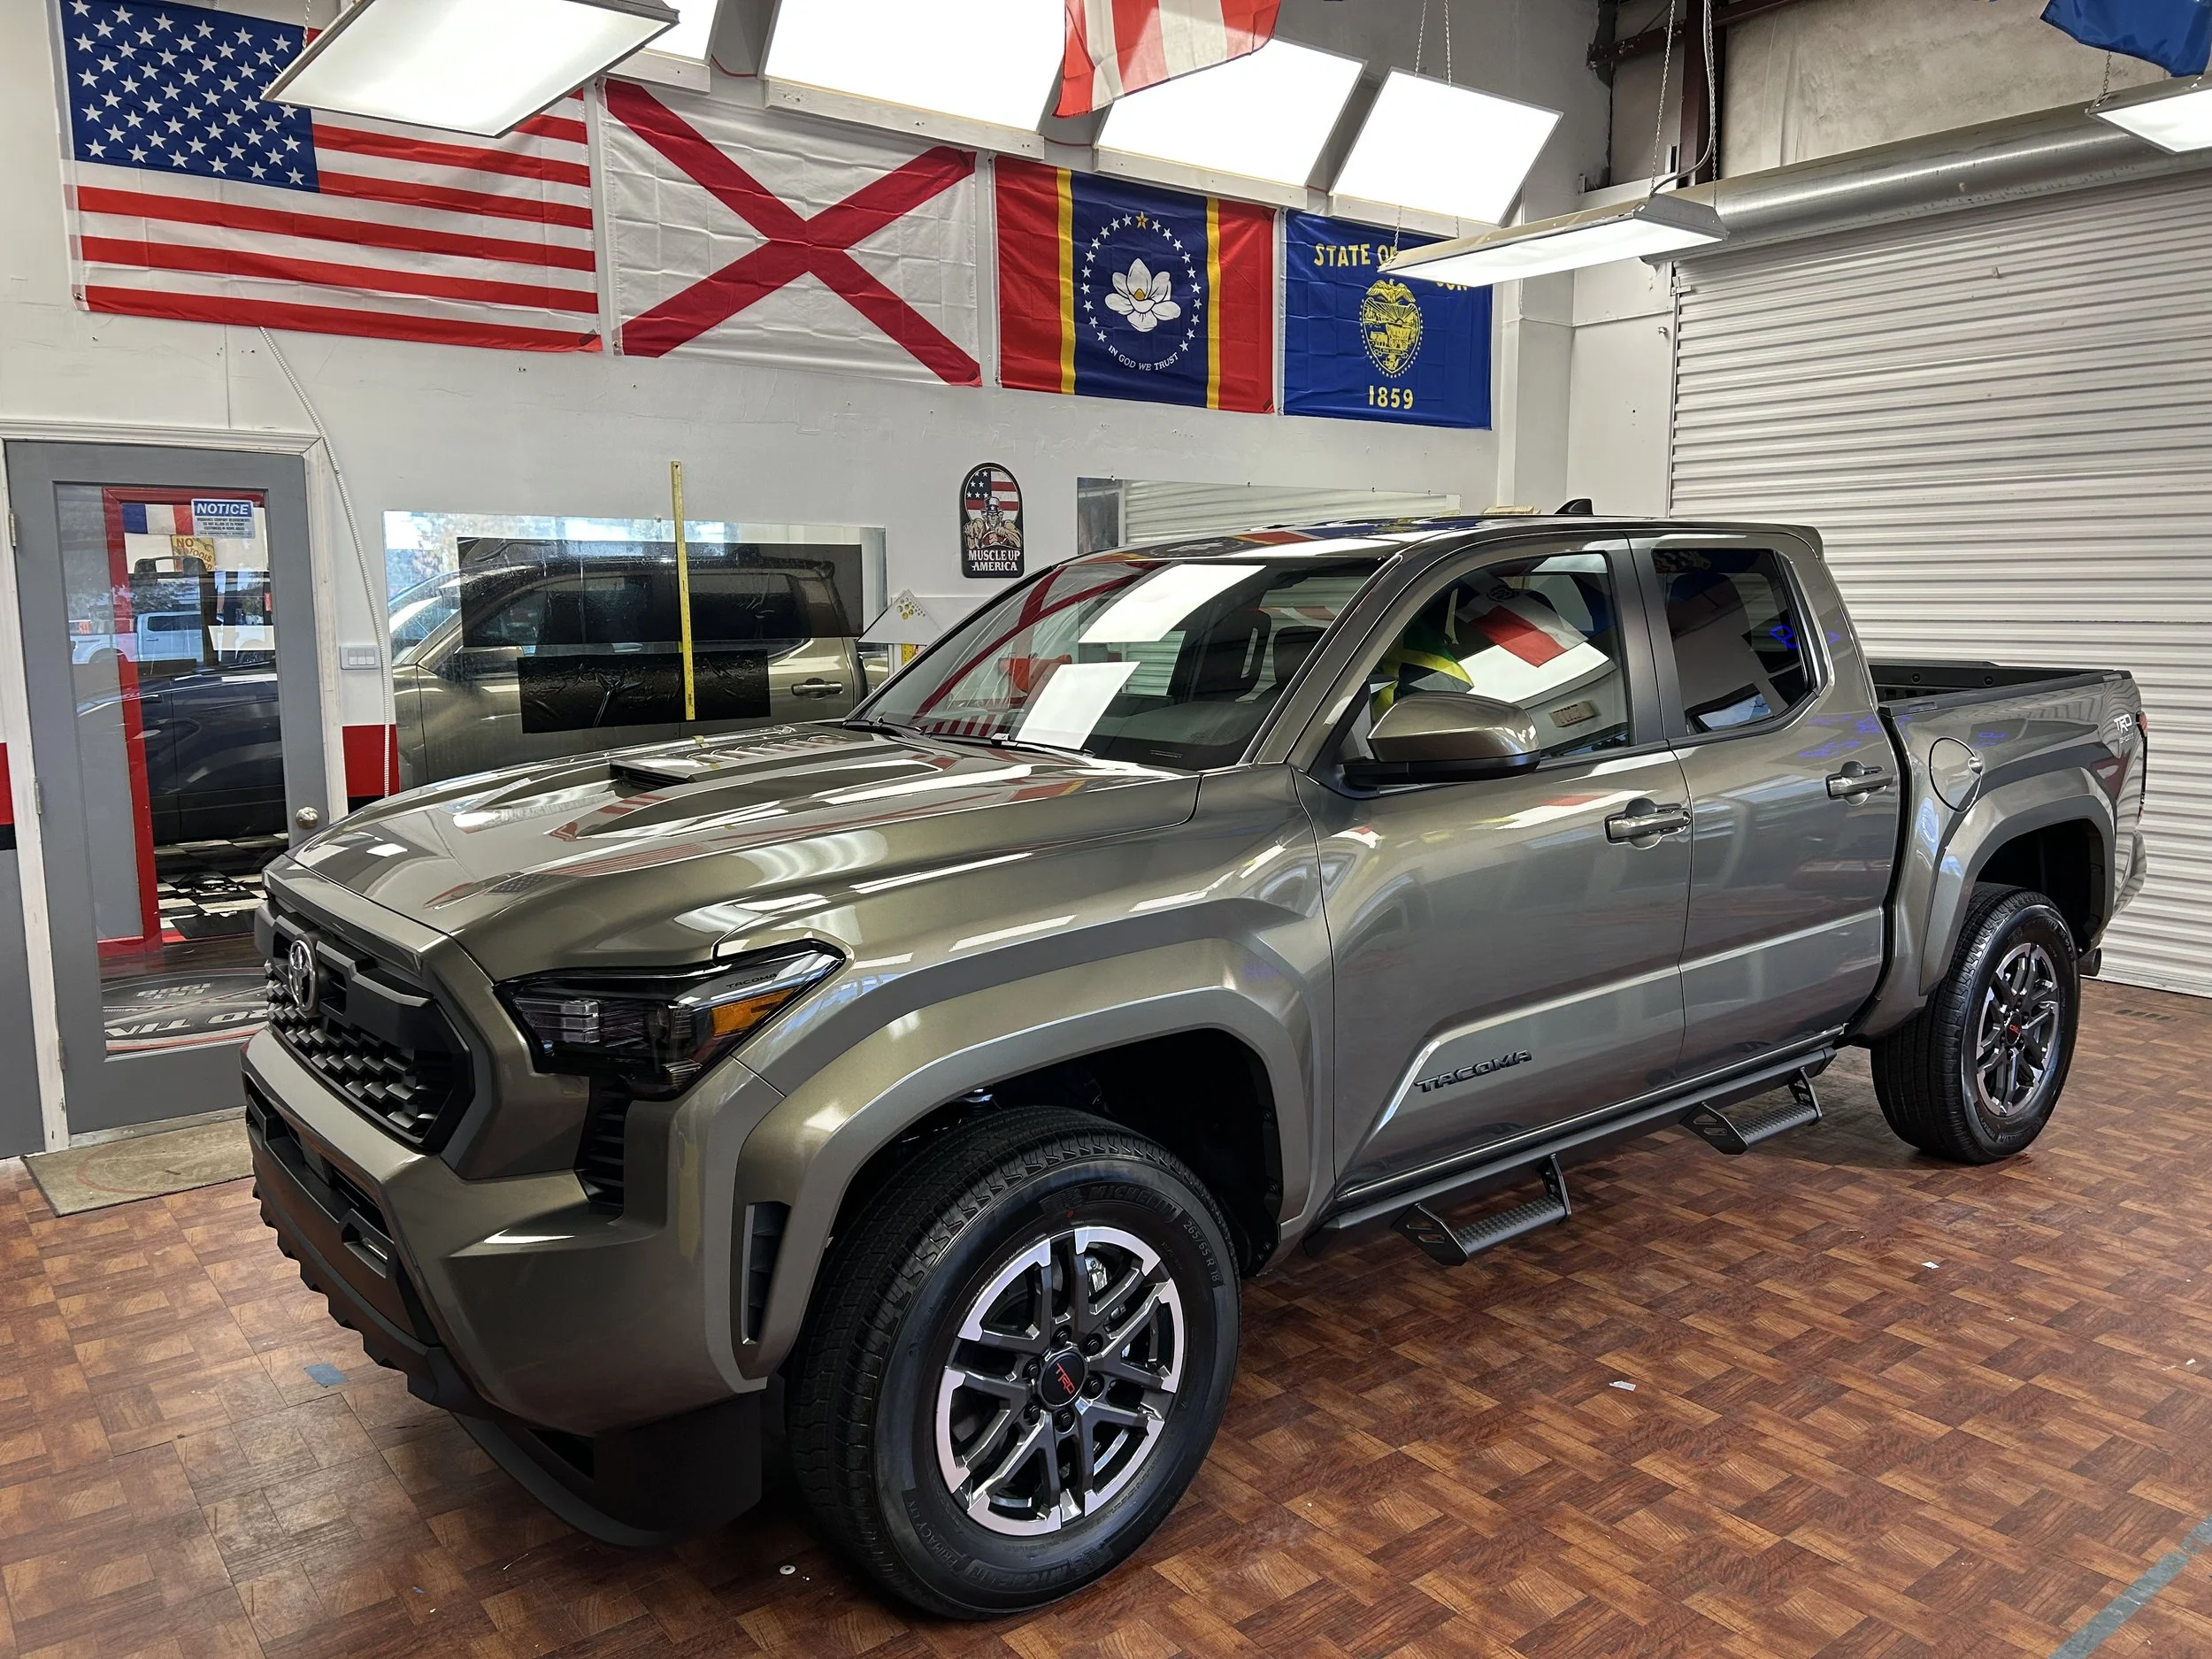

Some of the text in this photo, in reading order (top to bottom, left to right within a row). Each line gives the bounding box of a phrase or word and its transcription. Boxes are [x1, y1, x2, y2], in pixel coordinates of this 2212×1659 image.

[1314, 243, 1371, 267] STATE
[1108, 344, 1179, 372] IN GOD WE TRUST
[1369, 385, 1414, 410] 1859
[196, 503, 249, 515] NOTICE
[177, 538, 194, 548] NO
[190, 548, 212, 562] TOOLS
[968, 549, 1021, 561] MUSCLE UP
[972, 561, 1018, 571] AMERICA
[2114, 713, 2132, 733] TRD
[726, 973, 778, 988] TACOMA
[1413, 1049, 1532, 1093] TACOMA
[1088, 1186, 1179, 1216] MICHELIN
[1183, 1219, 1211, 1256] 265/65
[1206, 1258, 1215, 1267] R
[1210, 1271, 1220, 1282] 18
[1056, 1363, 1075, 1395] TRD
[915, 1520, 959, 1567] PRIMACY
